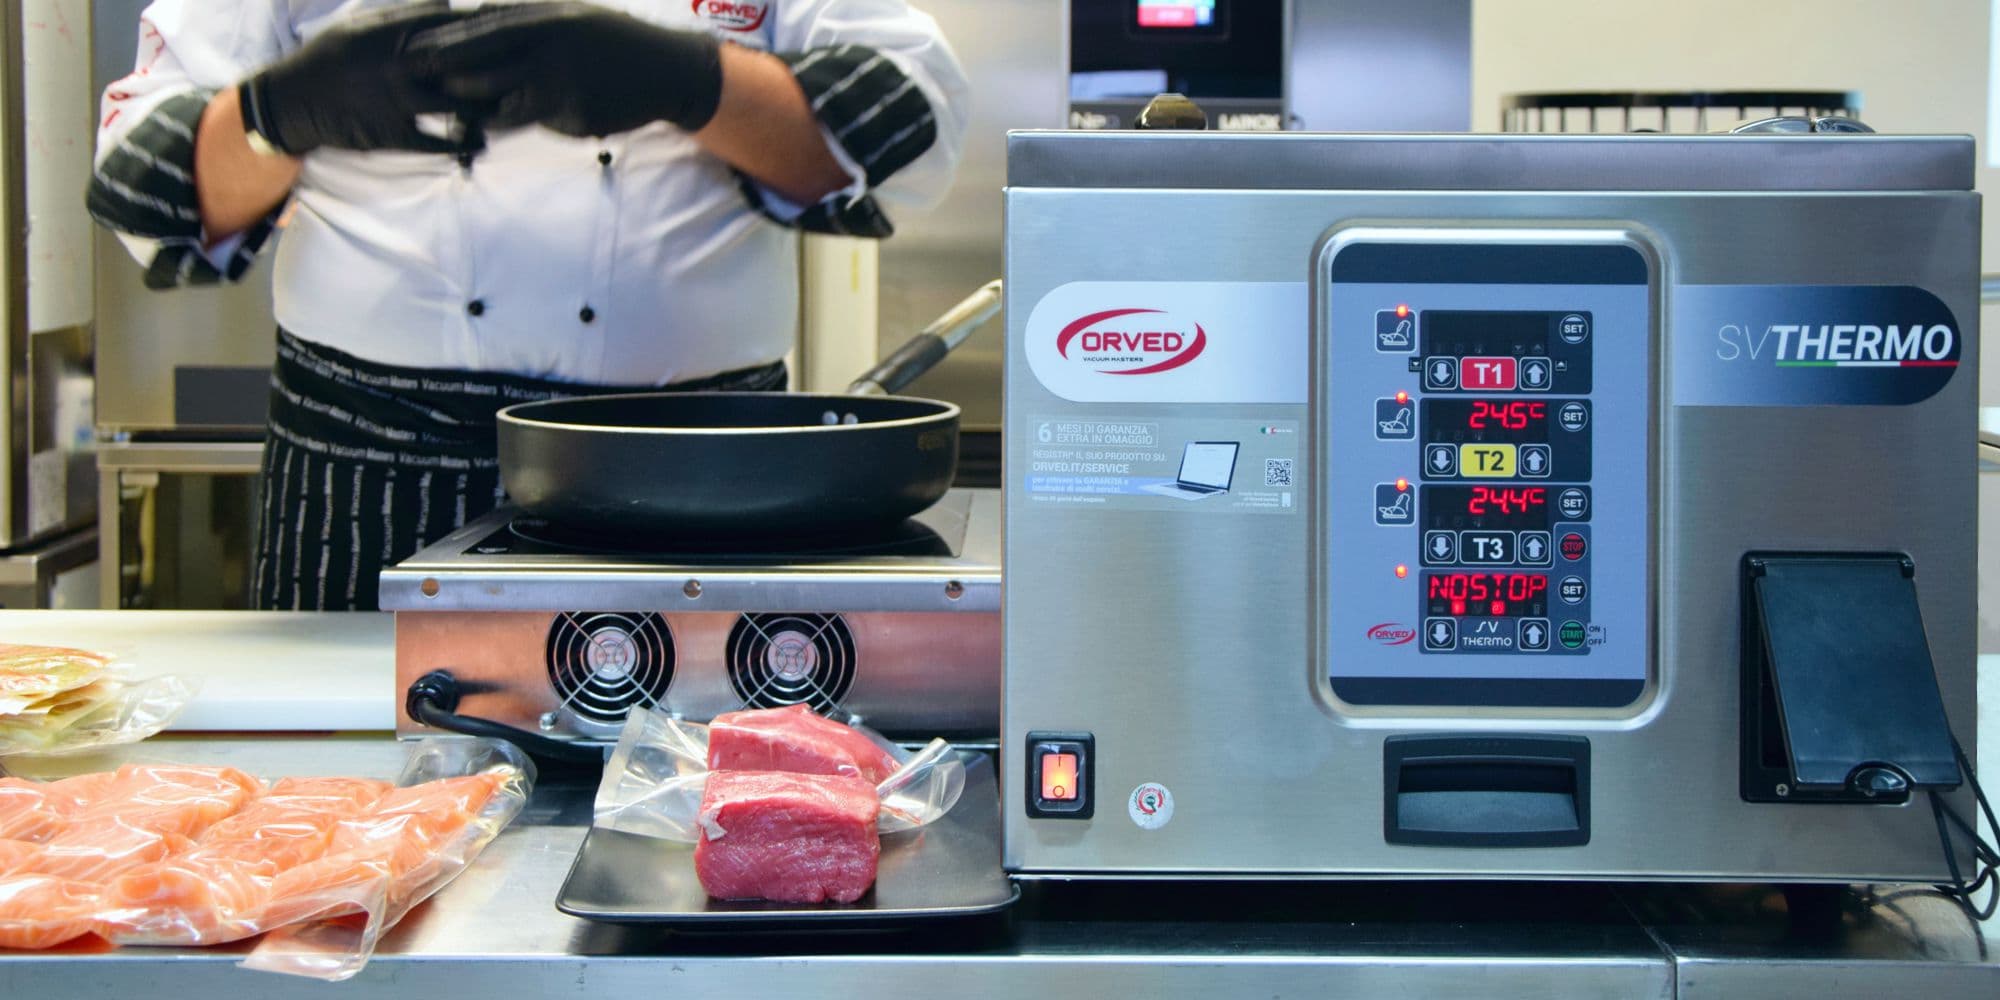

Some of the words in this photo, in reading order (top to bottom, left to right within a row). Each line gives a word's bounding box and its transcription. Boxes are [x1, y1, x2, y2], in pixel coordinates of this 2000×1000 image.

[1564, 324, 1584, 334] SET
[1473, 362, 1503, 385] T1
[1563, 411, 1583, 422] SET
[1038, 423, 1052, 442] 6
[1057, 423, 1081, 434] MESI
[1084, 424, 1094, 434] DI
[1097, 425, 1148, 435] GARANZIA
[1057, 433, 1089, 443] EXTRA
[1092, 434, 1102, 443] IN
[1104, 434, 1153, 445] OMAGGIO
[1105, 452, 1150, 461] PRODOTTO
[1473, 450, 1505, 471] T2
[1032, 462, 1130, 474] ORVED.IT/SERVICE
[1562, 498, 1583, 508] SET
[1472, 537, 1504, 560] T3
[1562, 541, 1584, 551] STOP
[1563, 585, 1583, 595] SET
[1375, 630, 1409, 638] ORVED
[1561, 629, 1583, 639] START
[1588, 625, 1600, 633] ON
[1462, 637, 1512, 647] THERMO
[1588, 638, 1602, 647] OFF
